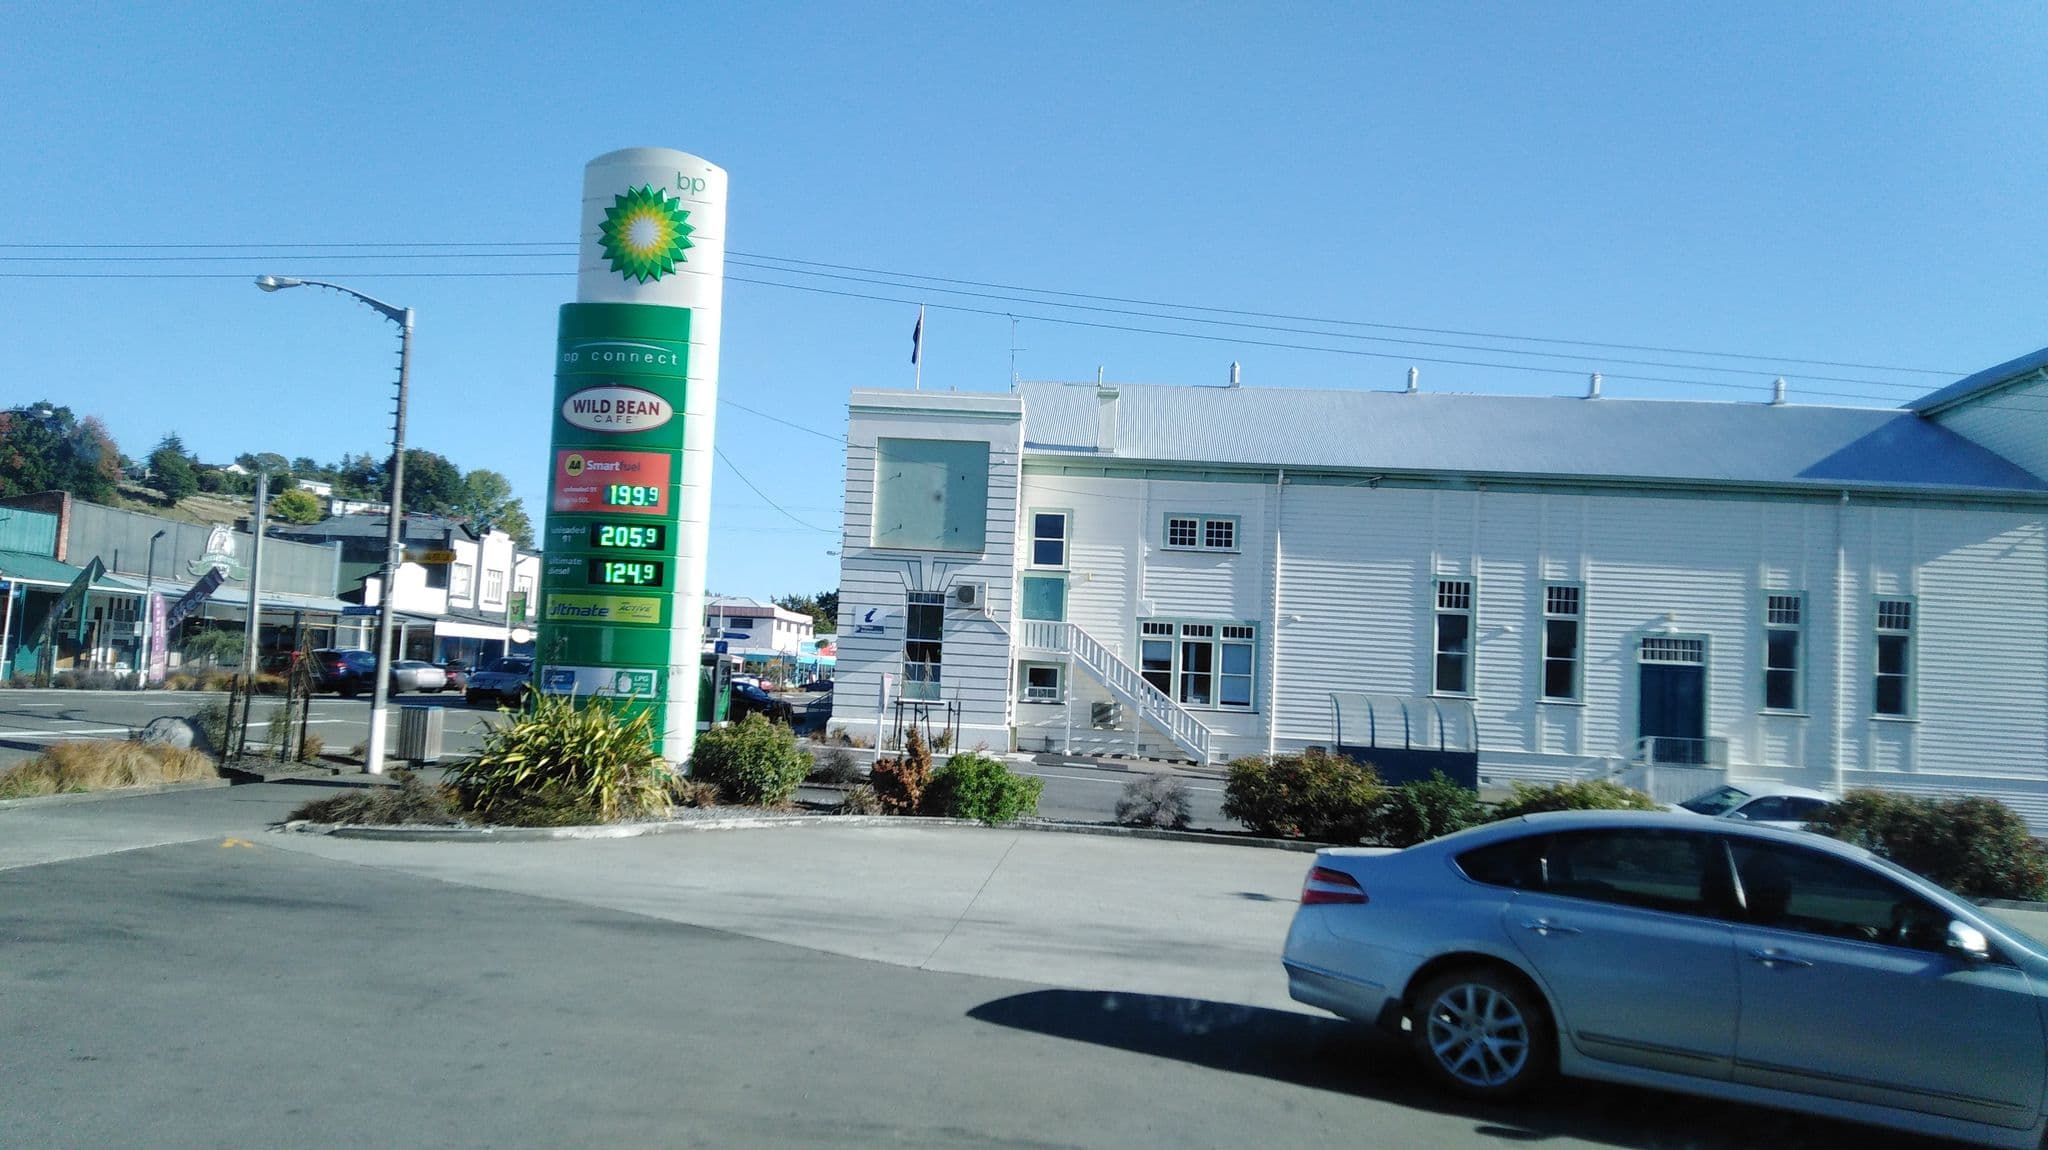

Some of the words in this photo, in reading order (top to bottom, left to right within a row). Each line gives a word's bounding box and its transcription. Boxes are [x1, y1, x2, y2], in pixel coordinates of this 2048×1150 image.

[676, 171, 706, 195] bp
[591, 351, 677, 365] connect
[573, 399, 611, 414] WILD
[615, 400, 660, 416] BEAN
[593, 414, 633, 424] CAFE
[568, 460, 581, 470] AA
[610, 484, 660, 506] 199.9
[600, 525, 657, 547] 205.9
[604, 561, 654, 584] 124.9
[634, 674, 649, 682] LPG
